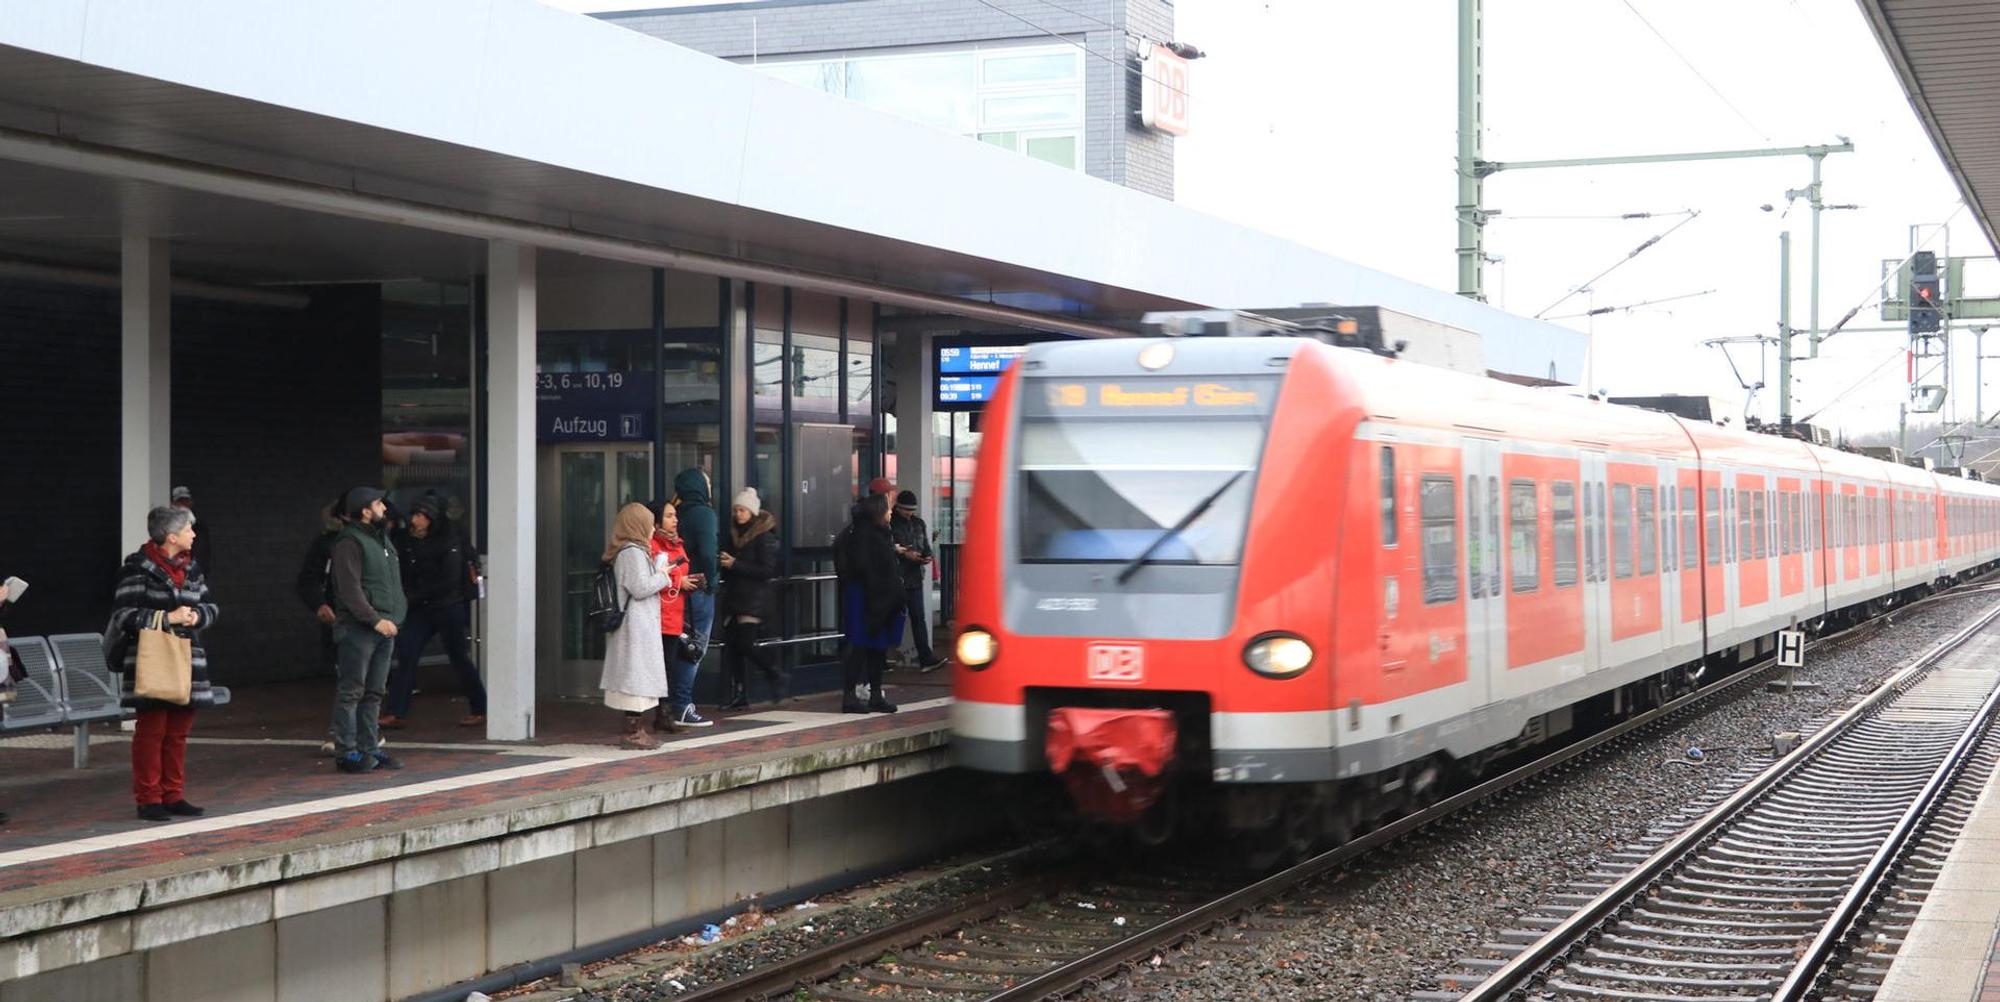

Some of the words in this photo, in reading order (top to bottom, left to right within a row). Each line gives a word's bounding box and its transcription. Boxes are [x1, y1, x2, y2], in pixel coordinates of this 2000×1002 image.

[1156, 58, 1187, 123] DB
[970, 360, 1000, 370] Hennef
[561, 373, 571, 389] 6
[553, 416, 607, 437] Aufzug
[1781, 634, 1801, 664] H
[1093, 647, 1138, 678] DB
